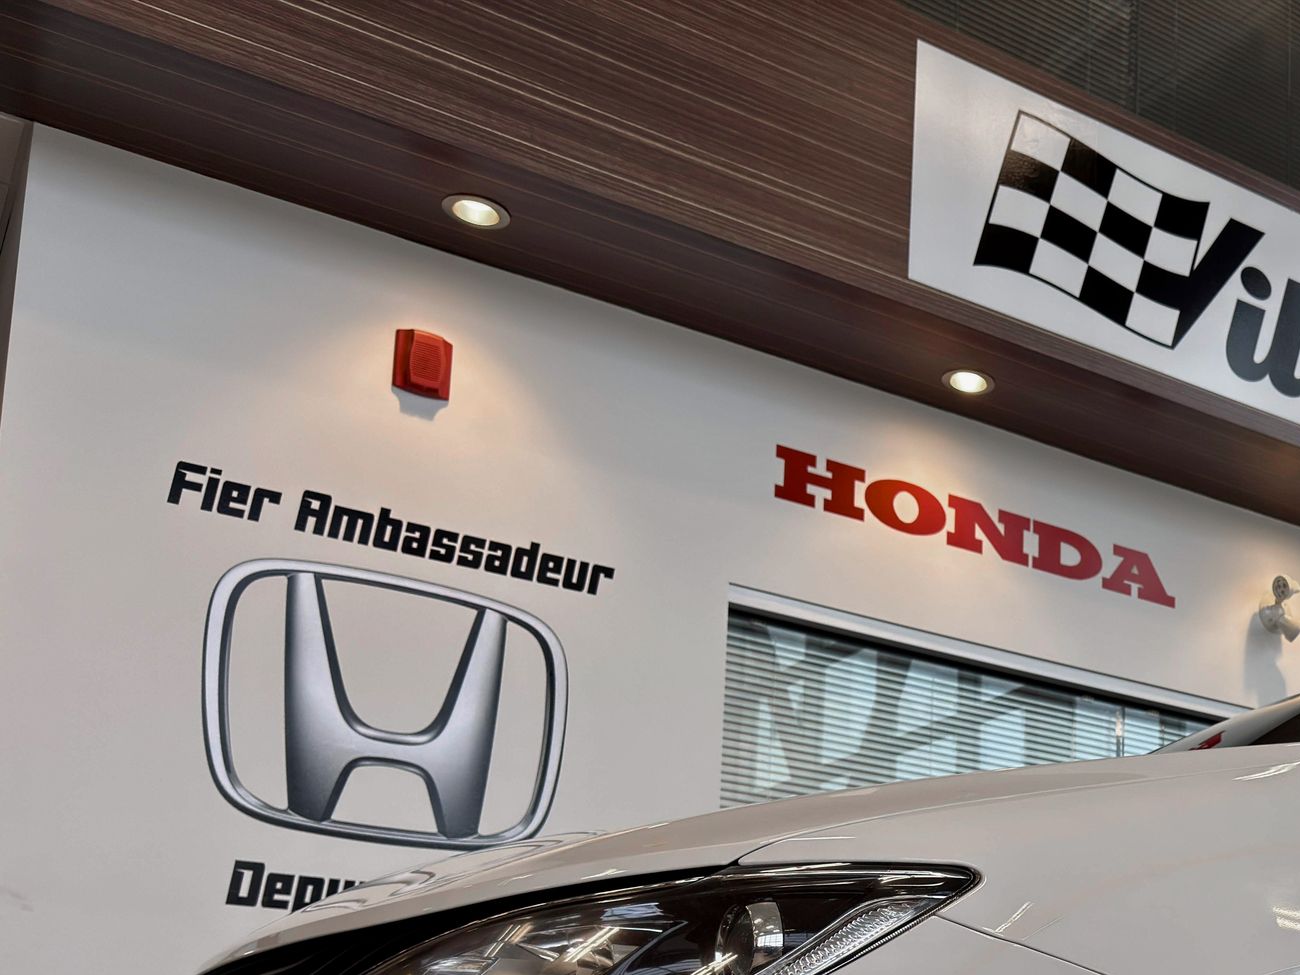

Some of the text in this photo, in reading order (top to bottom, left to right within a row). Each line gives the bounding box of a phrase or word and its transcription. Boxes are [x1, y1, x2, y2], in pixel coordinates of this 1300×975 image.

[167, 461, 615, 595] Fier Ambassadeur
[774, 444, 1176, 608] HONDA
